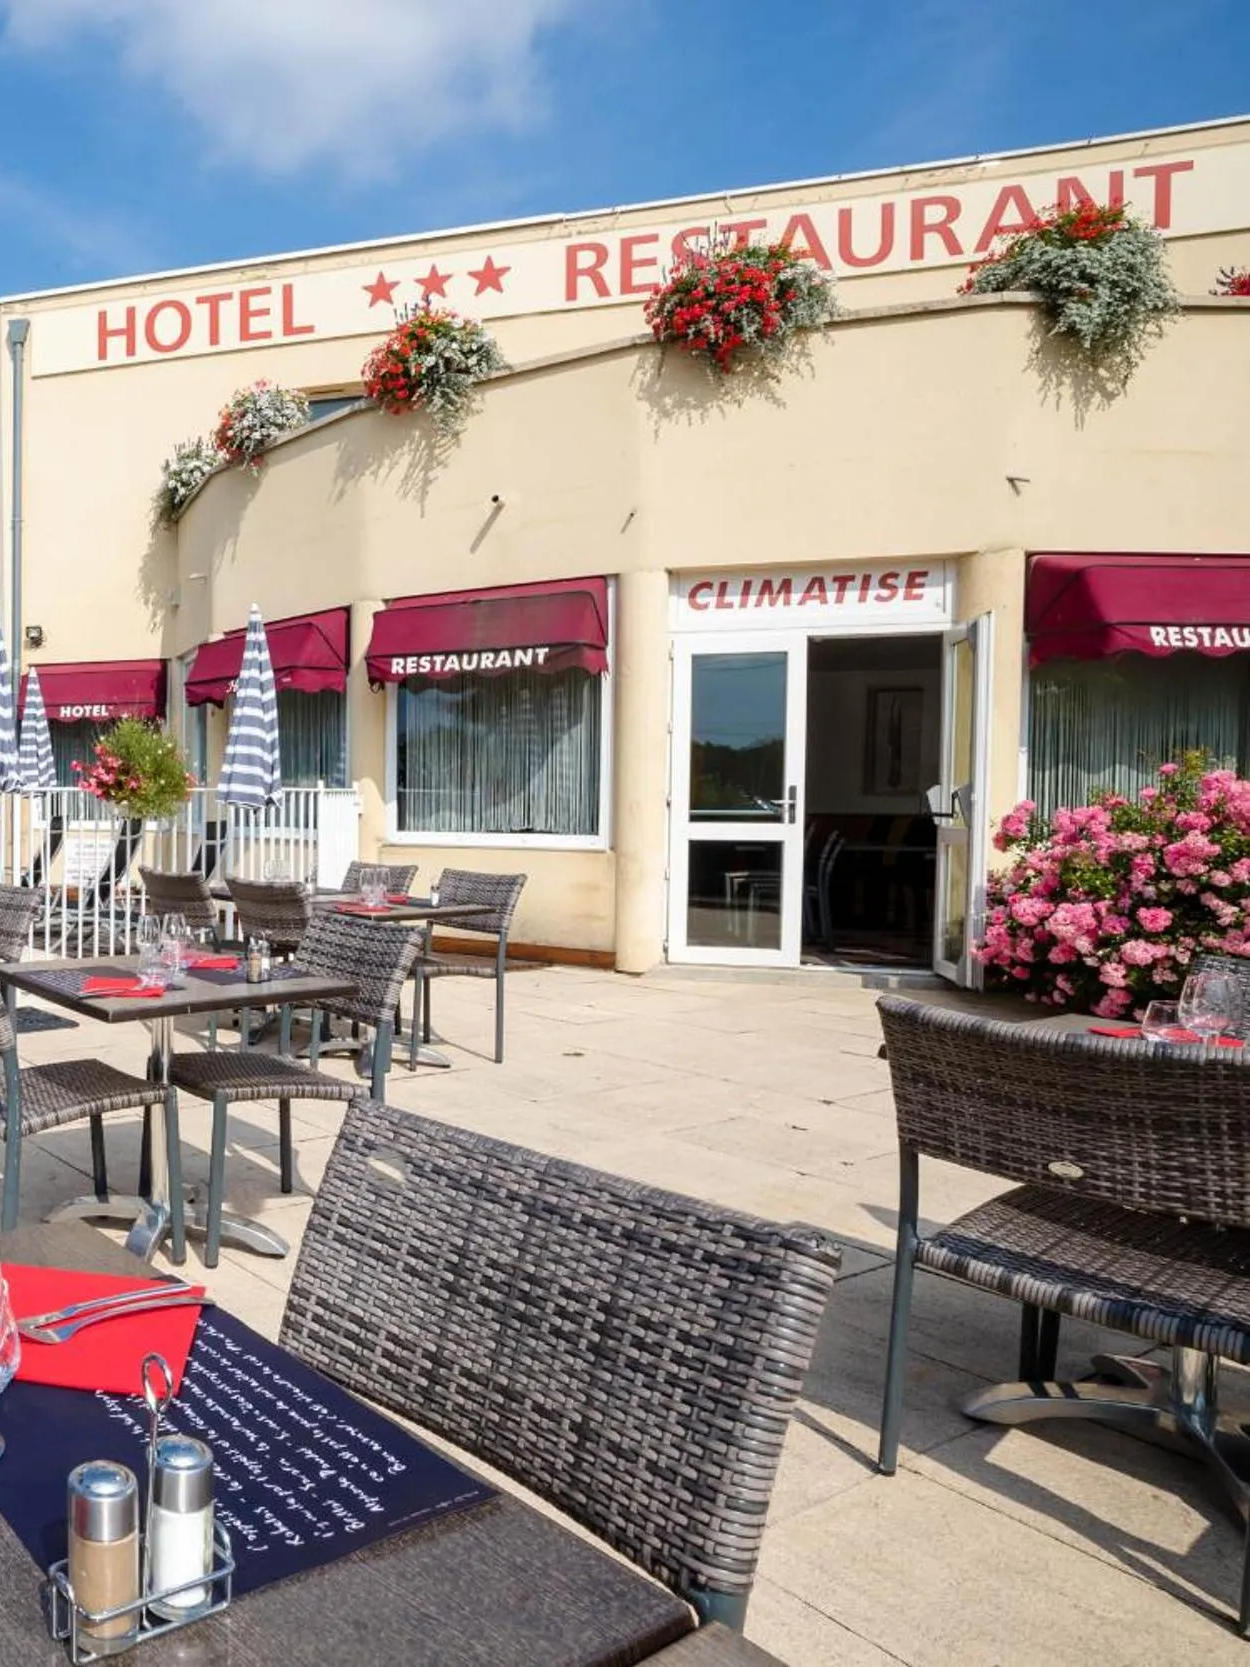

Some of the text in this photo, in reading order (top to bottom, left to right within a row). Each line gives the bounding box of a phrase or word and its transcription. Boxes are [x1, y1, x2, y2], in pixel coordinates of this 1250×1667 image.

[97, 283, 315, 361] HOTEL
[688, 570, 930, 612] CLIMATISE
[1150, 626, 1250, 648] RESTAU
[390, 647, 549, 675] RESTAURANT
[59, 704, 109, 718] HOTEL
